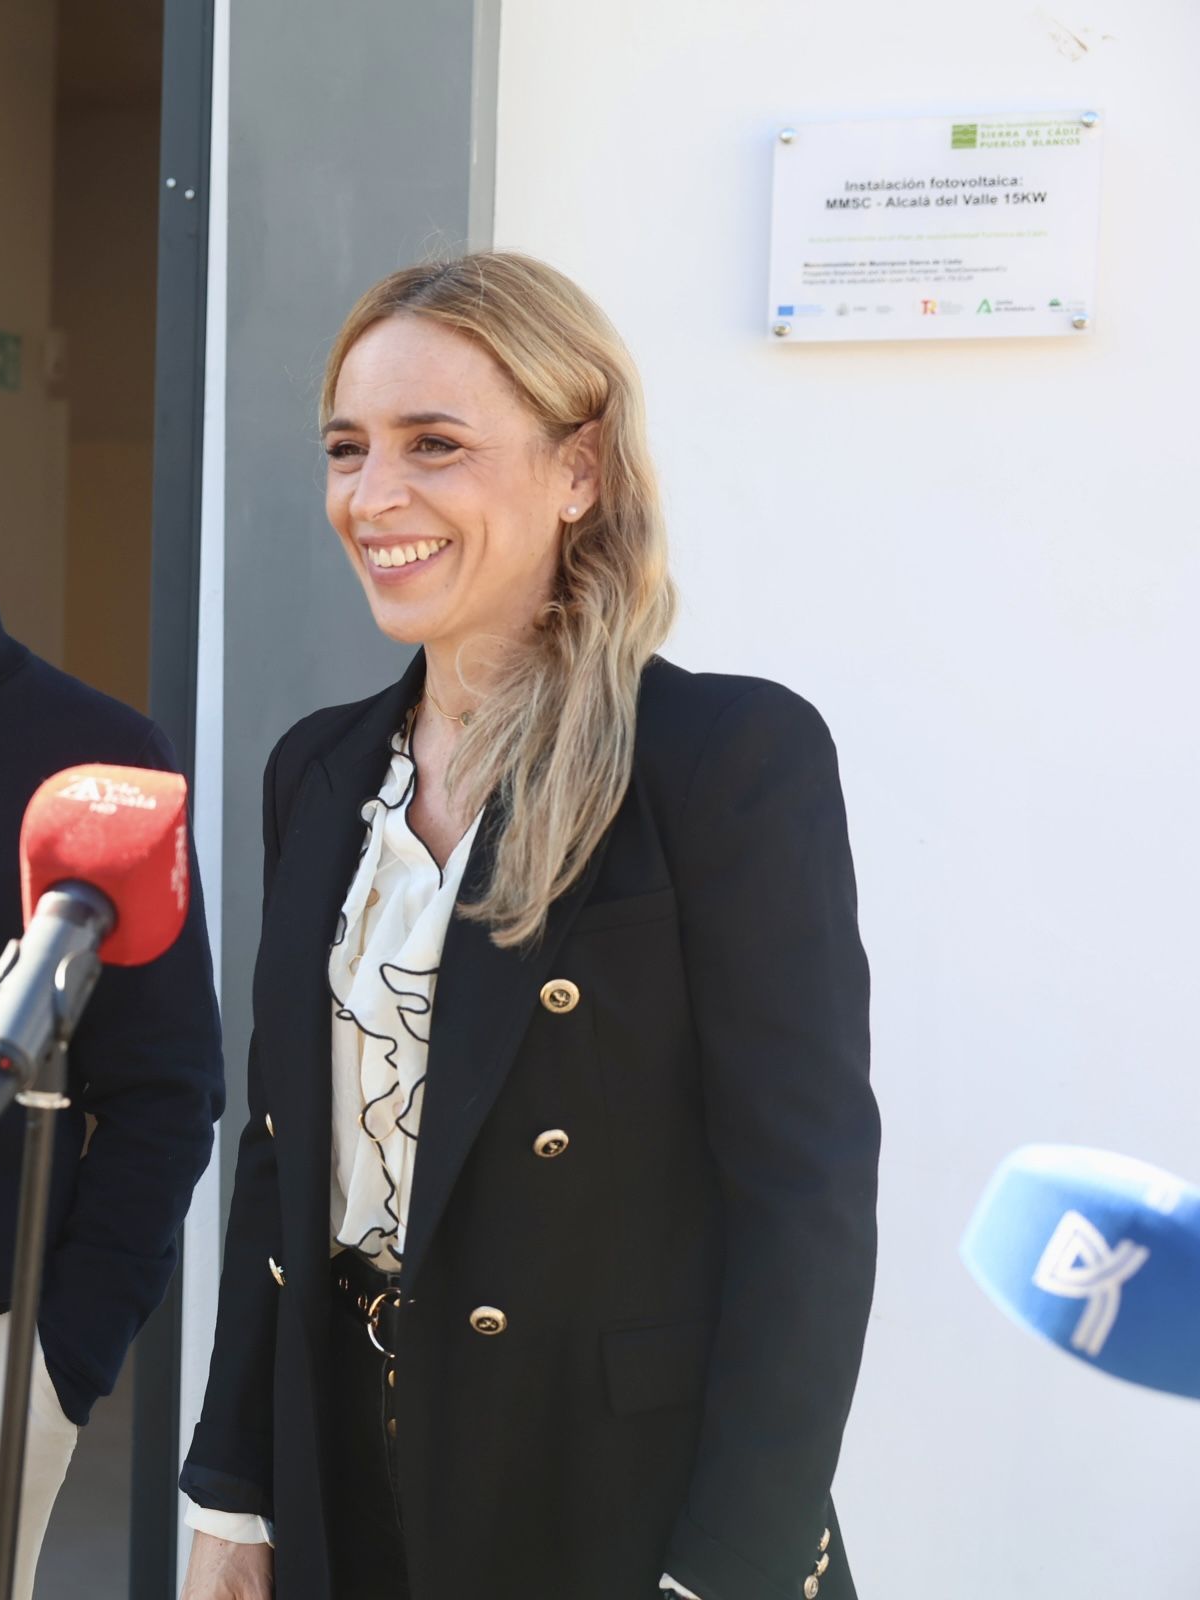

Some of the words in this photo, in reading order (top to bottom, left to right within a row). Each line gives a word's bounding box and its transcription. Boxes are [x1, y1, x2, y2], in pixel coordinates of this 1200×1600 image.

[1027, 129, 1041, 137] DE
[980, 140, 1027, 148] PUEBLOS
[1032, 138, 1081, 147] BLANCOS
[845, 175, 926, 192] Instalación
[930, 175, 1024, 189] fotovoltaica:
[825, 197, 872, 210] MMSC
[885, 194, 931, 208] Alcalá
[935, 194, 959, 207] del
[963, 193, 998, 206] Valle
[1004, 191, 1048, 205] 15KW
